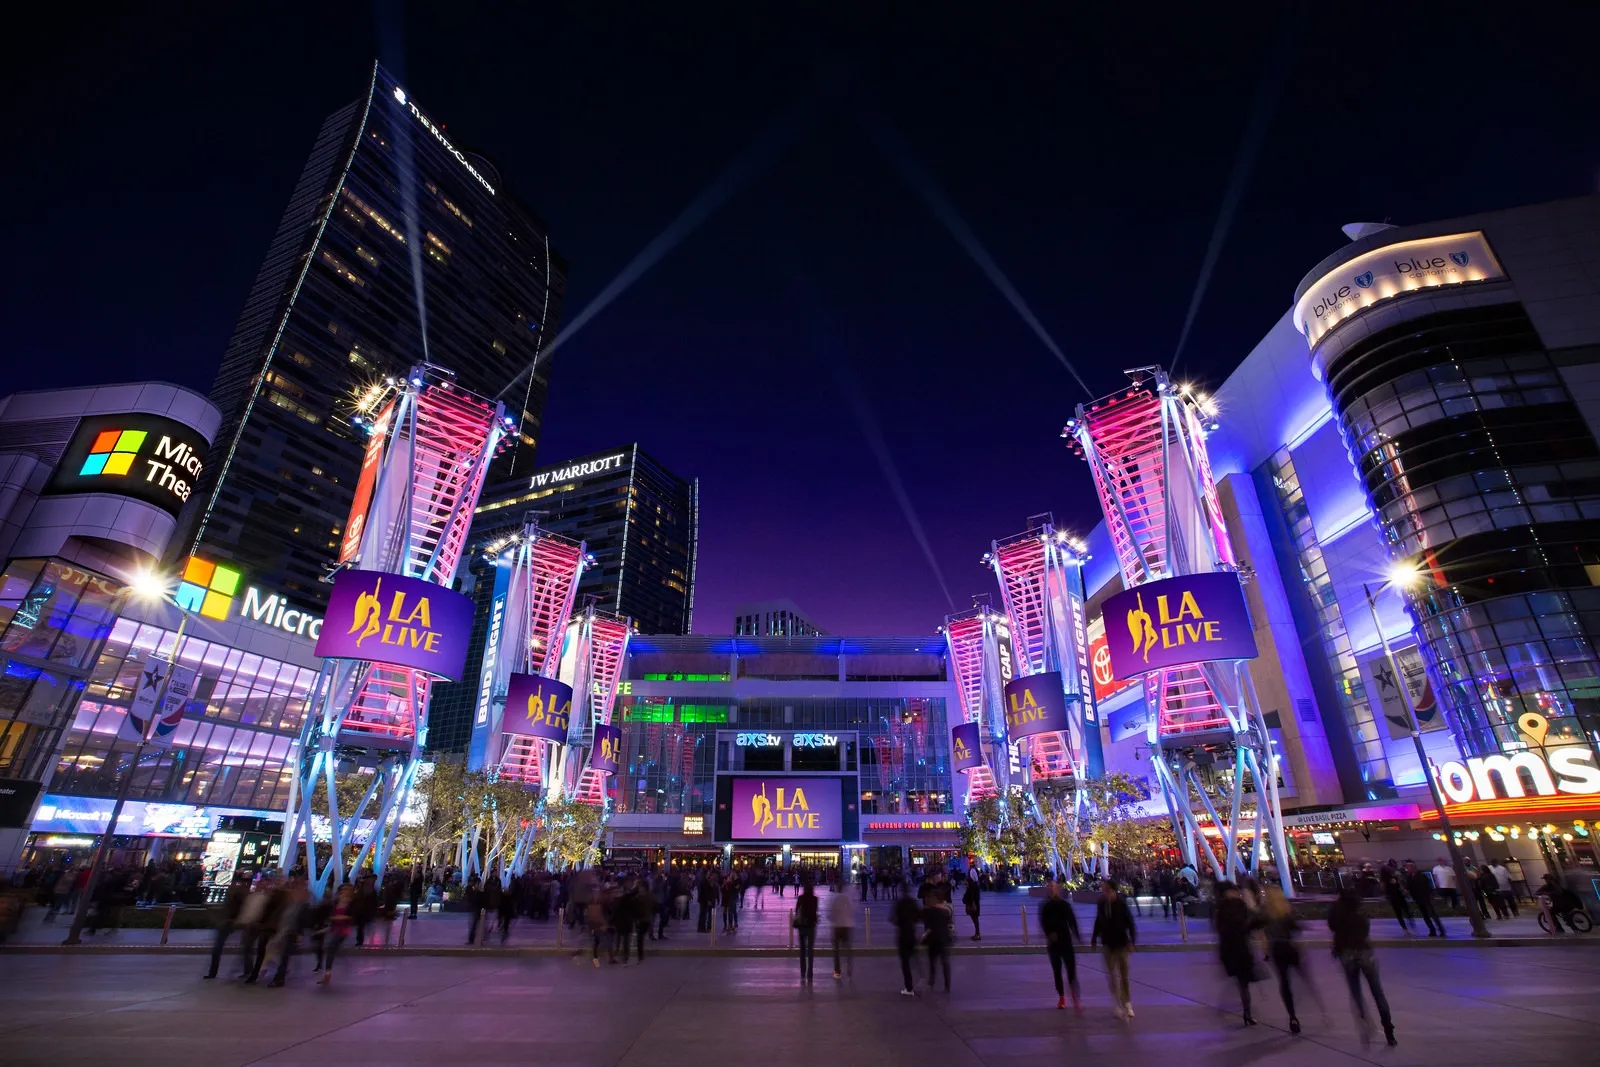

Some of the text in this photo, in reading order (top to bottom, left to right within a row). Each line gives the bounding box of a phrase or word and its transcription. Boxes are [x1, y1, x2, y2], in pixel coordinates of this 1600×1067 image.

[1394, 257, 1446, 274] blue
[1409, 267, 1457, 279] california
[1313, 285, 1351, 319] blue
[1322, 292, 1361, 321] california
[154, 435, 203, 481] Micr
[529, 454, 625, 489] JW MARRIOTT
[241, 586, 324, 640] Micro
[388, 591, 432, 628] LA
[1157, 590, 1204, 625] LA
[381, 624, 442, 653] LIVE
[1161, 621, 1222, 649] LIVE
[478, 599, 504, 724] BUD LIGHT
[1000, 643, 1012, 679] CAP
[1071, 598, 1095, 722] BUD LIGHT
[547, 694, 572, 717] LA
[1010, 688, 1037, 713] LA
[1014, 706, 1049, 727] LIVE
[776, 787, 809, 811] LA
[776, 813, 820, 829] LIVE
